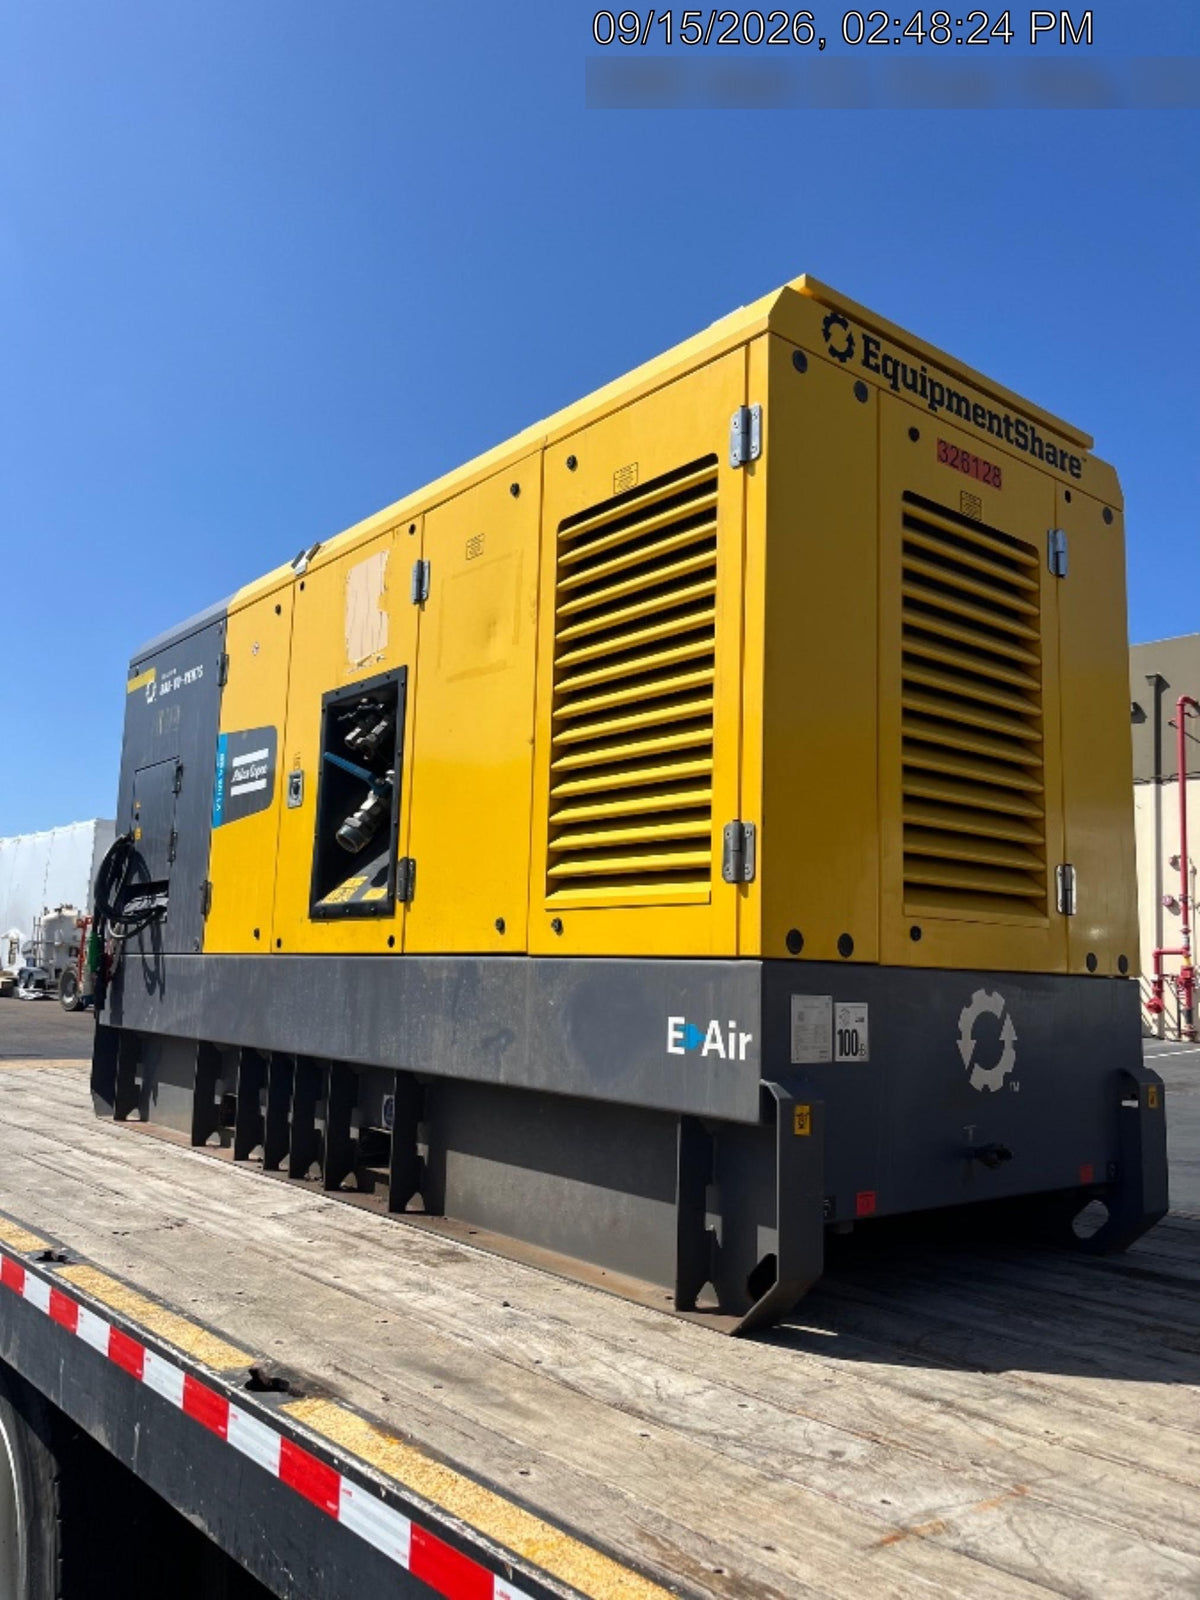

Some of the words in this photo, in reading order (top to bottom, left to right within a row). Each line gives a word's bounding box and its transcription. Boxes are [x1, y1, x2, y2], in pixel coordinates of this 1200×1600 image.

[861, 333, 1082, 479] EquipmentShare
[937, 439, 1002, 489] 326128
[837, 1029, 858, 1057] 100
